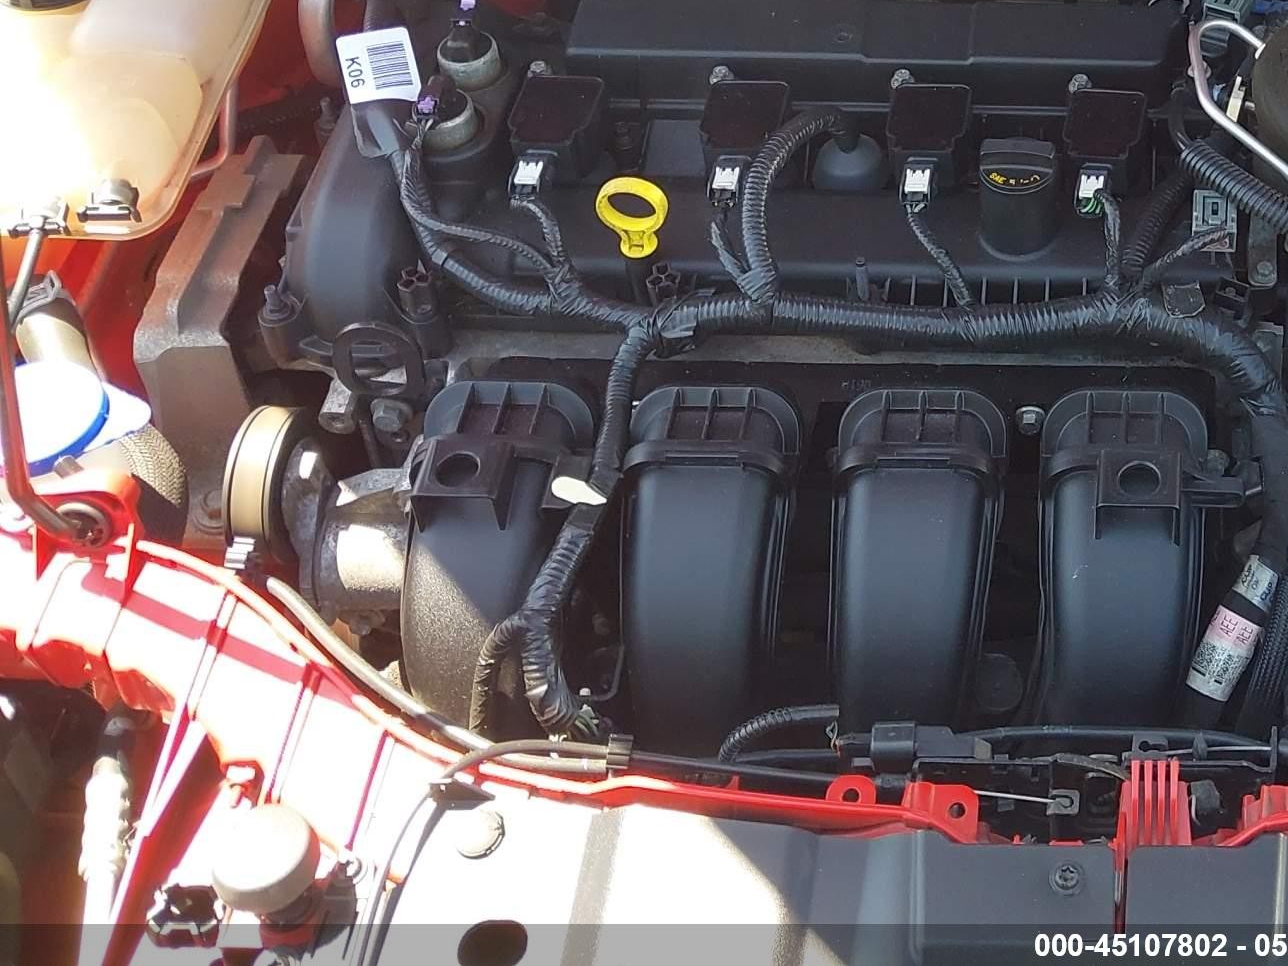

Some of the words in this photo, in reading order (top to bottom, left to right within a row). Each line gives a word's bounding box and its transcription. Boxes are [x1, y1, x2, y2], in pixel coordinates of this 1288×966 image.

[345, 56, 366, 88] K06
[1220, 614, 1238, 638] AEE
[1236, 626, 1254, 645] AEE
